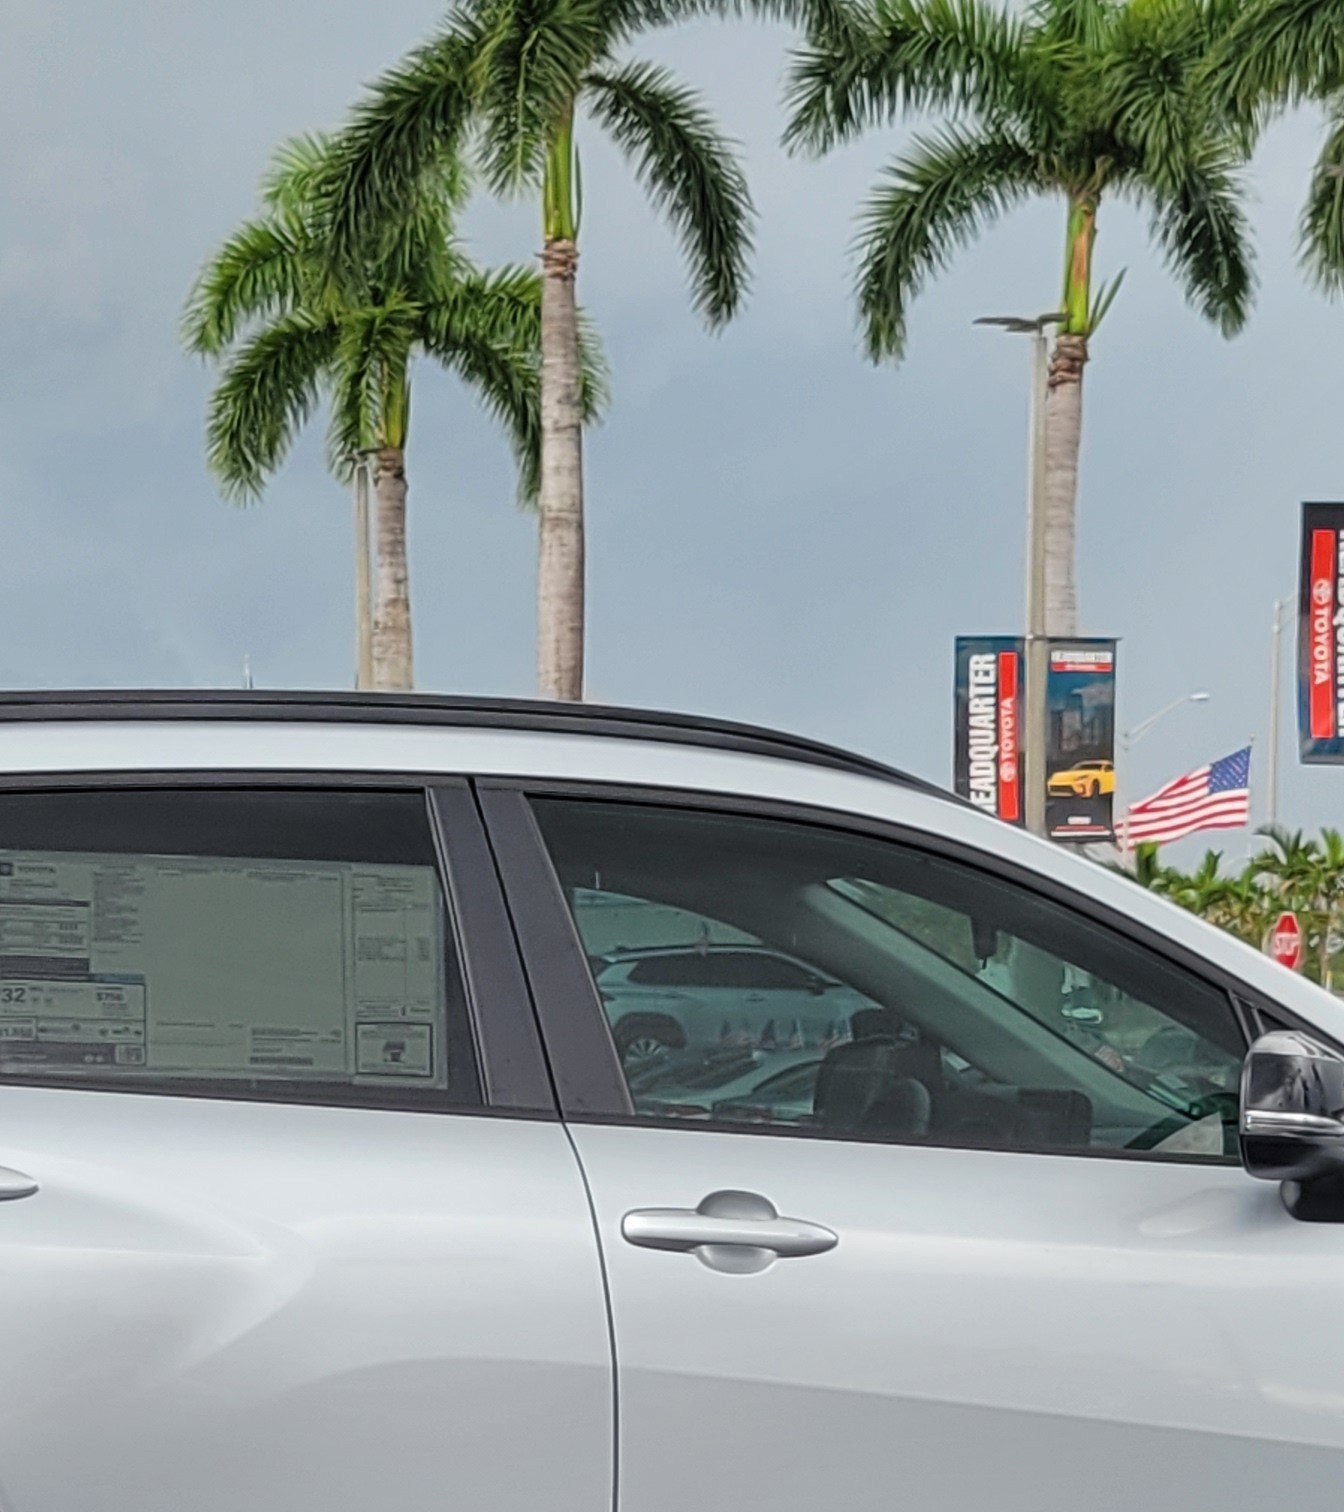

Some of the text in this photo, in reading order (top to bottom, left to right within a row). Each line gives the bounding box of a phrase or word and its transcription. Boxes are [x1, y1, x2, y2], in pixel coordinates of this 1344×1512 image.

[1314, 608, 1332, 685] TOYOTA
[1000, 697, 1014, 760] TOYOTA
[2, 987, 27, 1003] 32
